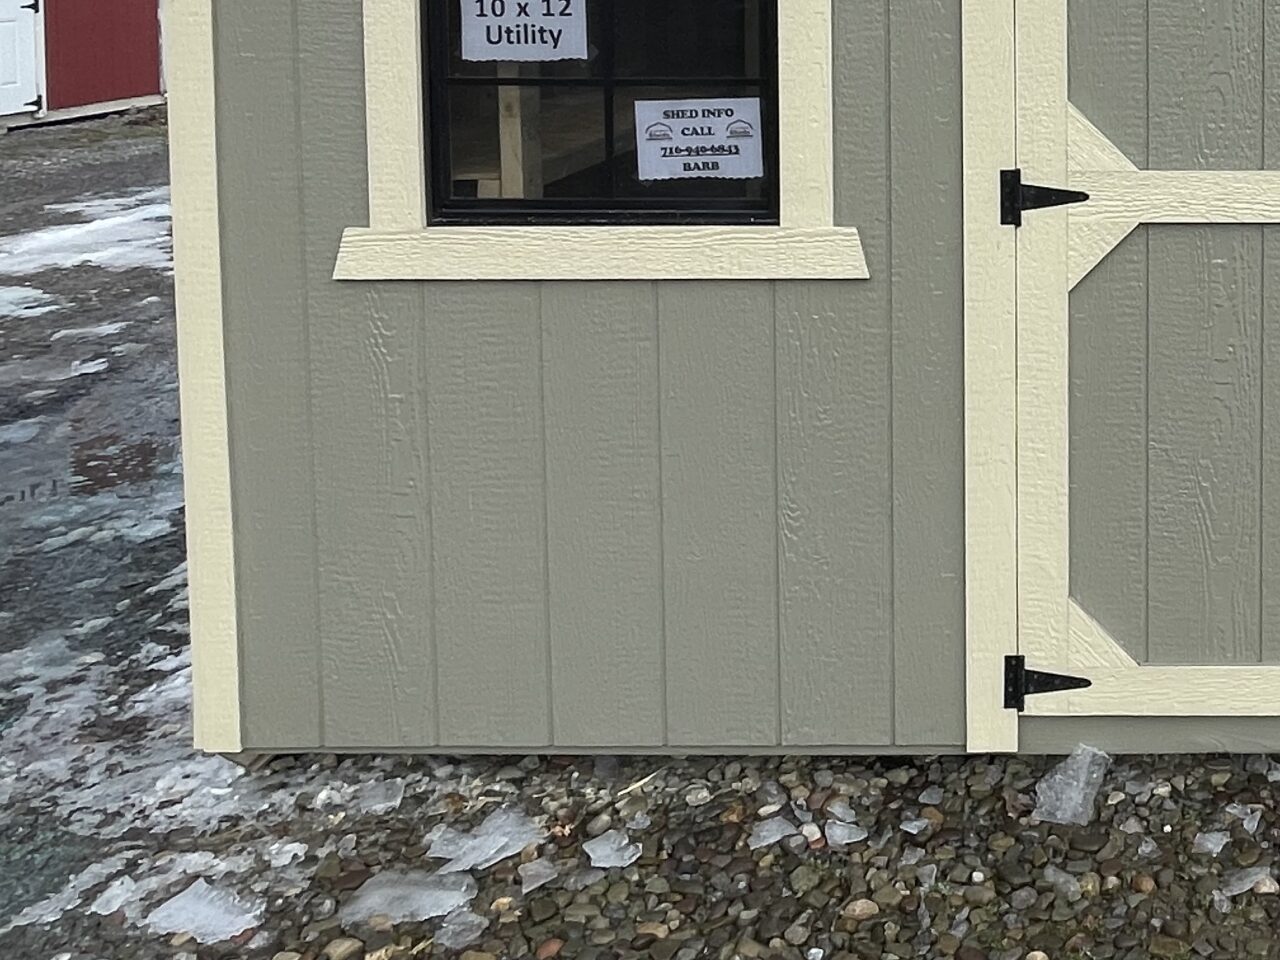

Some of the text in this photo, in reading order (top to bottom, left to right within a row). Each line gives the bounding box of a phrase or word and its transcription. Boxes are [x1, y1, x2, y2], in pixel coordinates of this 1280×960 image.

[516, 2, 530, 17] x
[486, 23, 562, 49] Utility
[662, 108, 734, 119] SHED INFO
[681, 127, 715, 136] CALL
[683, 162, 719, 171] BARB
